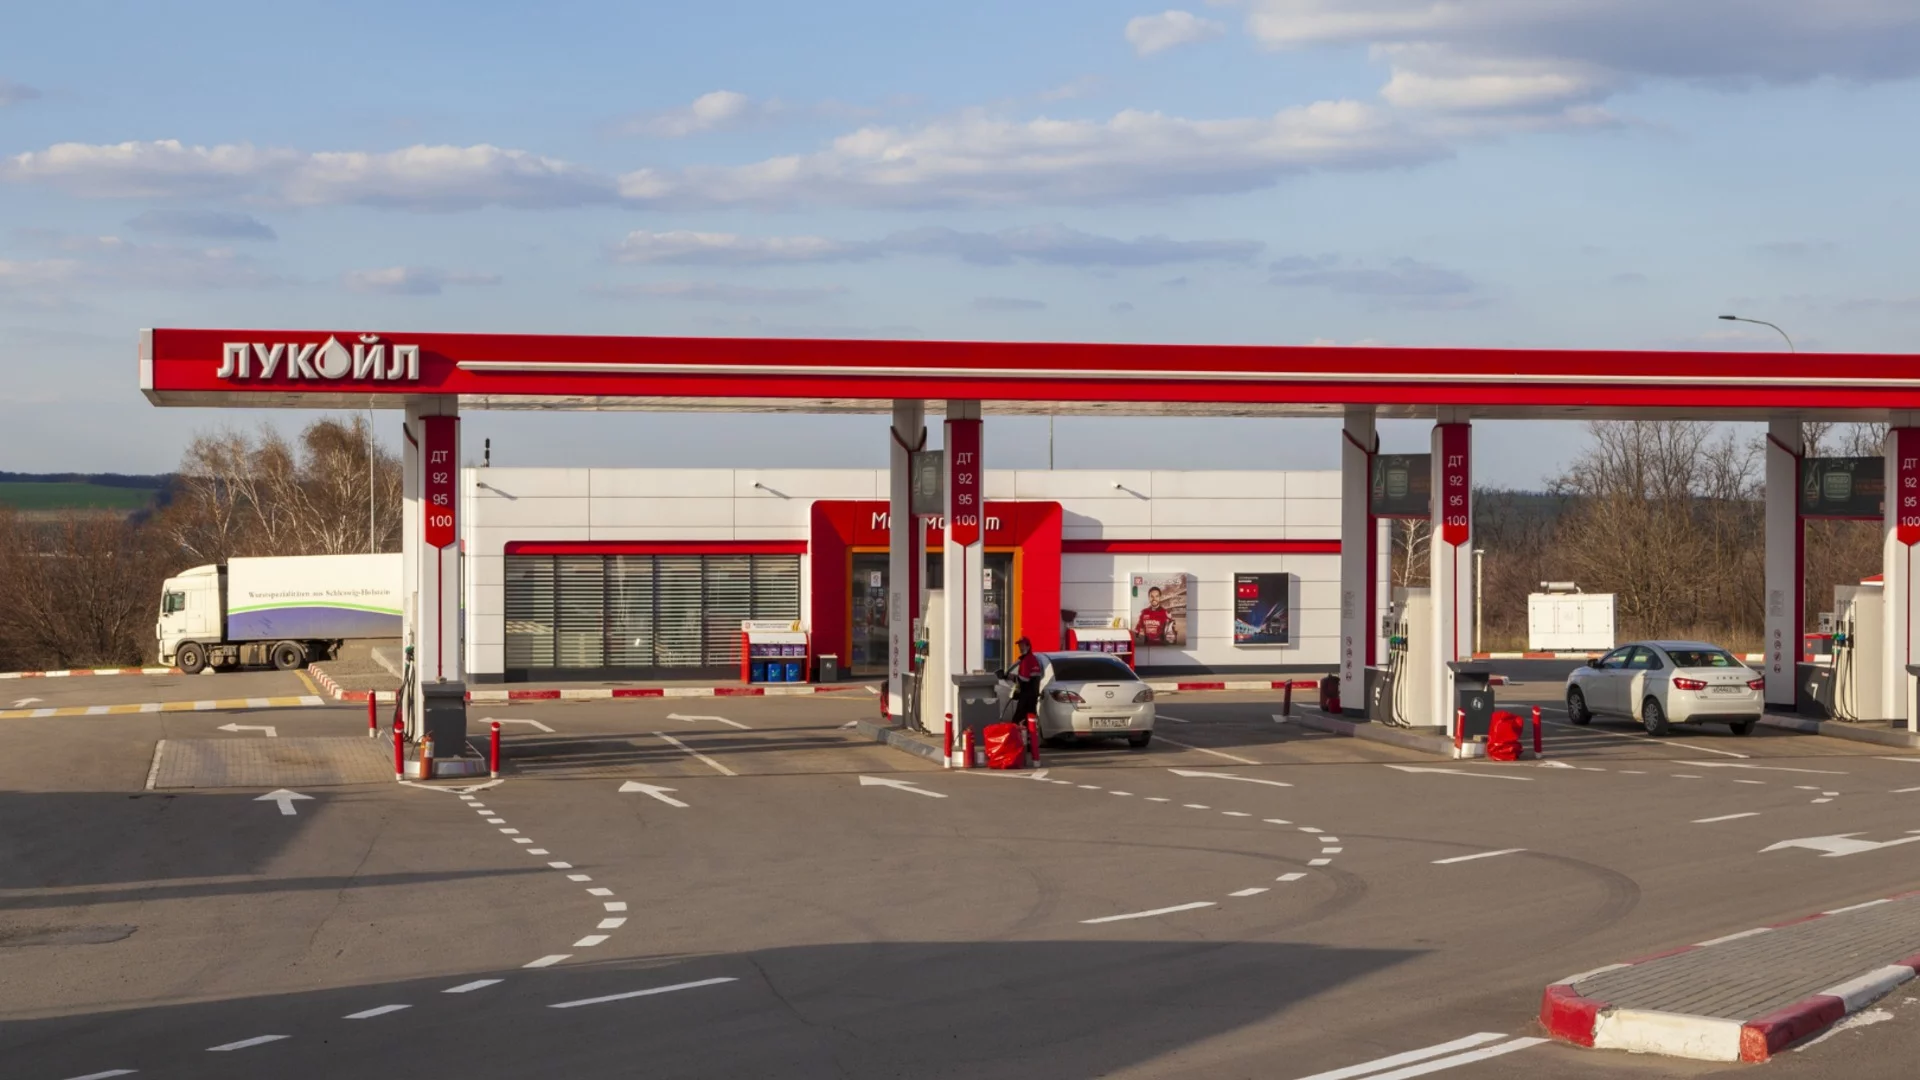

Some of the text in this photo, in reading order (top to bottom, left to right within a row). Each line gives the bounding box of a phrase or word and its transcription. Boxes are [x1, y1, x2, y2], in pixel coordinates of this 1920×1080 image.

[216, 333, 419, 380] ЛУКОЙЛ
[431, 450, 448, 464] ДТ
[956, 452, 973, 465] ДТ
[1448, 455, 1463, 468] ДТ
[1903, 458, 1918, 470] ДТ
[432, 472, 448, 484] 92
[958, 473, 973, 485] 92
[1449, 475, 1463, 486] 92
[1904, 477, 1917, 488] 92
[432, 493, 448, 505] 95
[958, 494, 973, 505] 95
[1449, 495, 1463, 506] 95
[1904, 497, 1917, 507] 95
[429, 515, 452, 527] 100
[955, 515, 977, 526] 100
[1446, 515, 1467, 526] 100
[1901, 516, 1920, 527] 100
[1811, 683, 1819, 699] 7
[907, 693, 912, 713] 3
